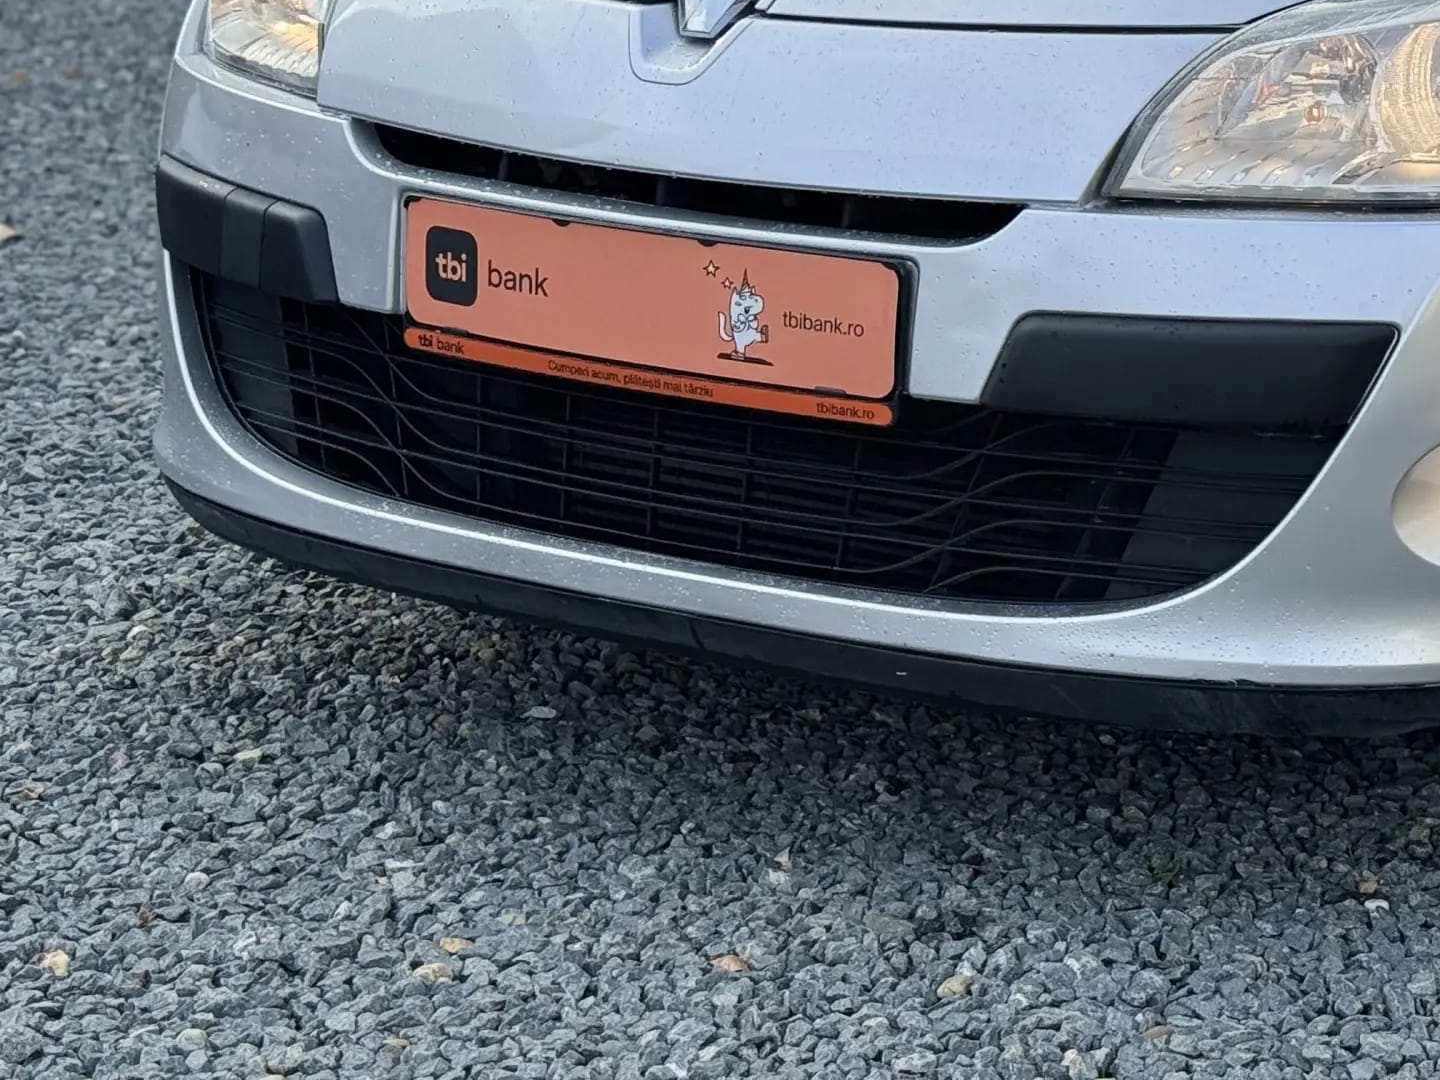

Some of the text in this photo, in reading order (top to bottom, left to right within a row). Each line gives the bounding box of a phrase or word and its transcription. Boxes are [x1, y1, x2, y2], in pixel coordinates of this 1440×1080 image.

[435, 251, 550, 298] tbi bank
[782, 310, 865, 338] tbibank.ro
[417, 333, 465, 355] tbi bank
[547, 359, 590, 378] Cumperi
[590, 368, 621, 384] acum,
[663, 380, 682, 394] mai
[815, 401, 875, 420] tbibank.ro
